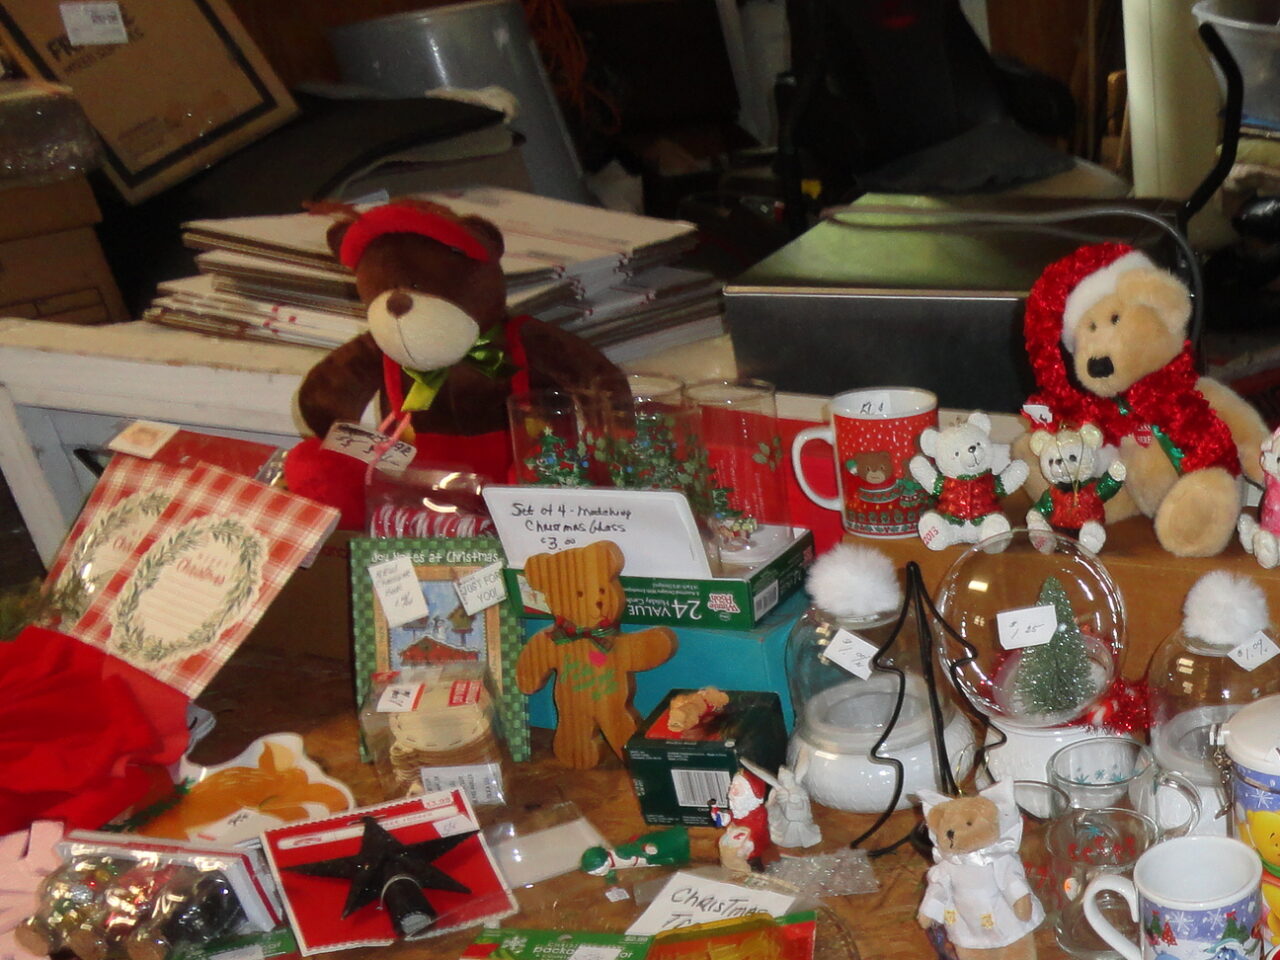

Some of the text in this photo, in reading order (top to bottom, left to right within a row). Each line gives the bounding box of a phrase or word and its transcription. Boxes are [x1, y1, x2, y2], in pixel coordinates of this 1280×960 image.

[511, 503, 535, 517] Set
[429, 553, 442, 563] at
[446, 551, 499, 563] Christmas
[629, 599, 703, 620] 24 VALUE
